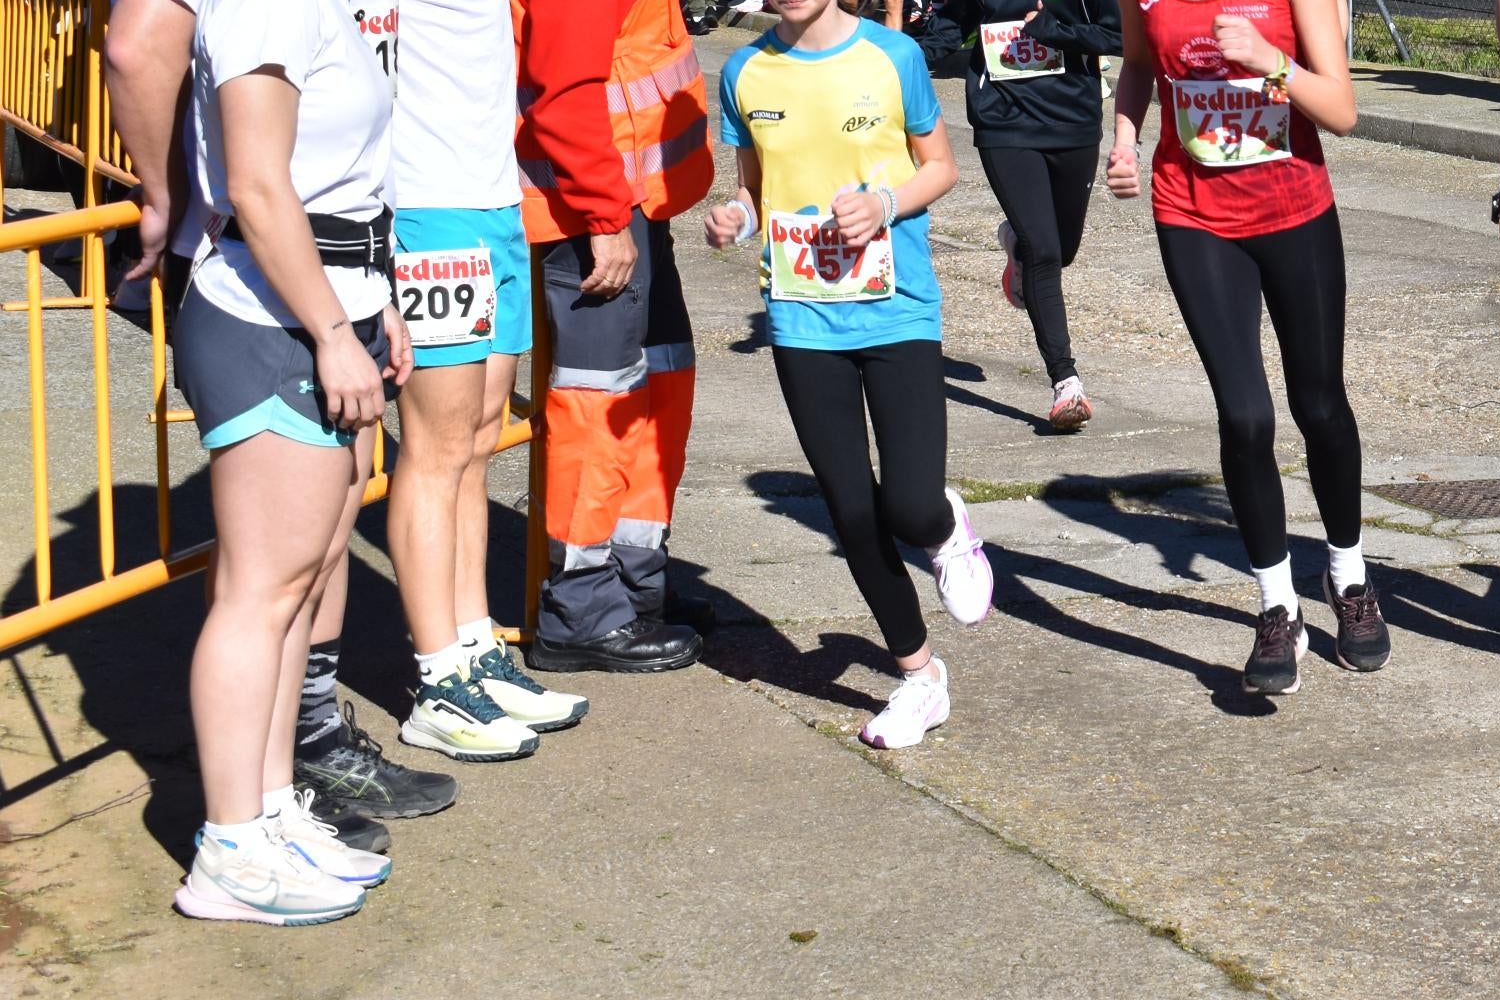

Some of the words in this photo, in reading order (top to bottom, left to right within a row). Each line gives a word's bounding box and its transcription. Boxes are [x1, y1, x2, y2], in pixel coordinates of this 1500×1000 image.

[1000, 40, 1048, 64] 455
[1196, 110, 1268, 145] 454
[394, 255, 491, 282] edunia
[793, 246, 867, 282] 457
[401, 283, 475, 322] 209
